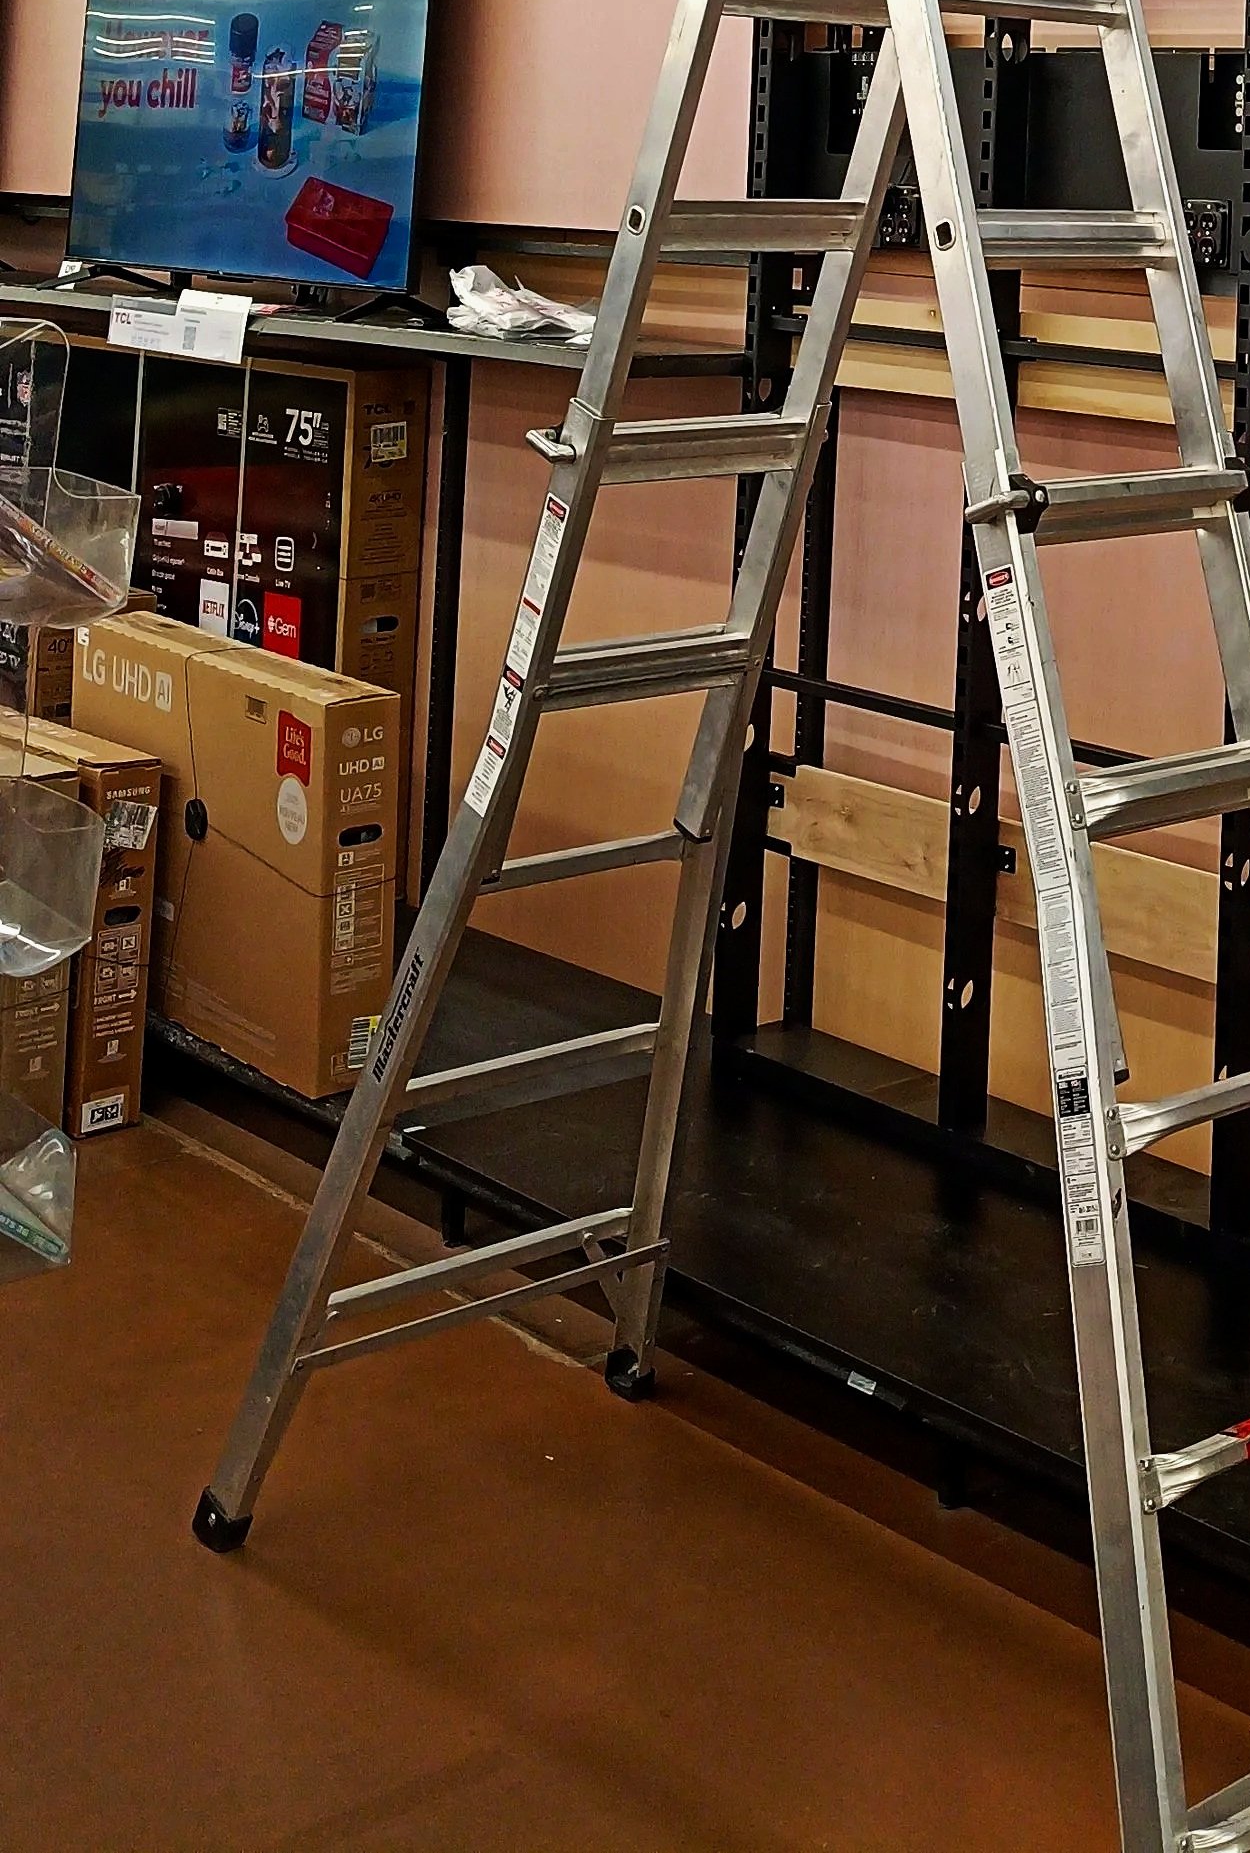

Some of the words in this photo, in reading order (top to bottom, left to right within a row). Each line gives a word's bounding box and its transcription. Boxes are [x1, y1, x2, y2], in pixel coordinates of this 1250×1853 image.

[99, 80, 142, 118] you
[146, 68, 198, 109] chill
[114, 311, 132, 325] TCL
[275, 617, 297, 639] Gem
[82, 644, 106, 685] LG
[112, 655, 151, 702] UHD
[363, 725, 384, 743] LG
[339, 758, 369, 776] UHD
[106, 785, 151, 800] SAMSUNG
[340, 783, 383, 804] UA75
[371, 946, 425, 1085] Mastercraft
